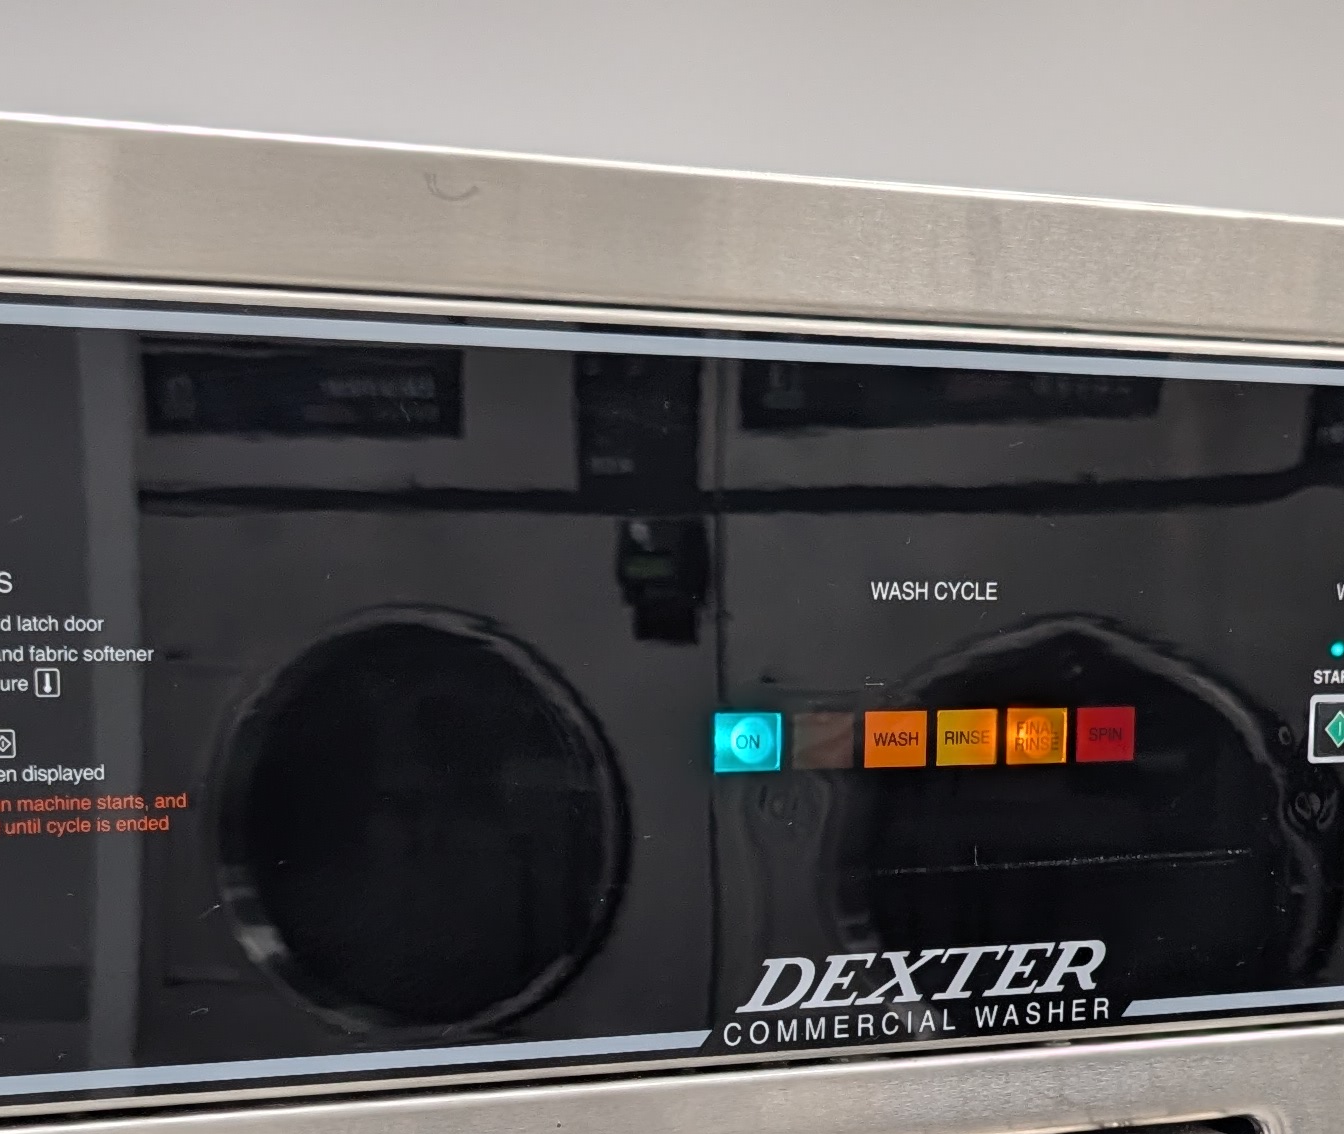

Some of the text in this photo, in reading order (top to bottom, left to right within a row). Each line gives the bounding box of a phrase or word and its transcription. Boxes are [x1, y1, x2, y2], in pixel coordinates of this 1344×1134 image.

[870, 581, 998, 601] WASH CYCLE
[17, 614, 59, 633] latch
[64, 614, 104, 633] door
[28, 645, 78, 663] fabric
[83, 645, 154, 662] softener
[1016, 720, 1059, 736] FINAL
[1088, 727, 1123, 742] SPIN
[735, 733, 761, 751] ON
[873, 732, 919, 748] WASH
[943, 730, 990, 745] RINSE
[1014, 736, 1060, 752] RINSE
[22, 764, 105, 784] displayed
[17, 795, 92, 812] machine
[96, 795, 149, 811] starts,
[154, 793, 187, 809] and
[5, 817, 41, 836] until
[46, 817, 91, 837] cycle
[96, 817, 111, 833] is
[115, 815, 170, 832] ended
[735, 940, 1107, 1015] DEXTER
[723, 997, 1110, 1048] COMMERCIAL WASHER
